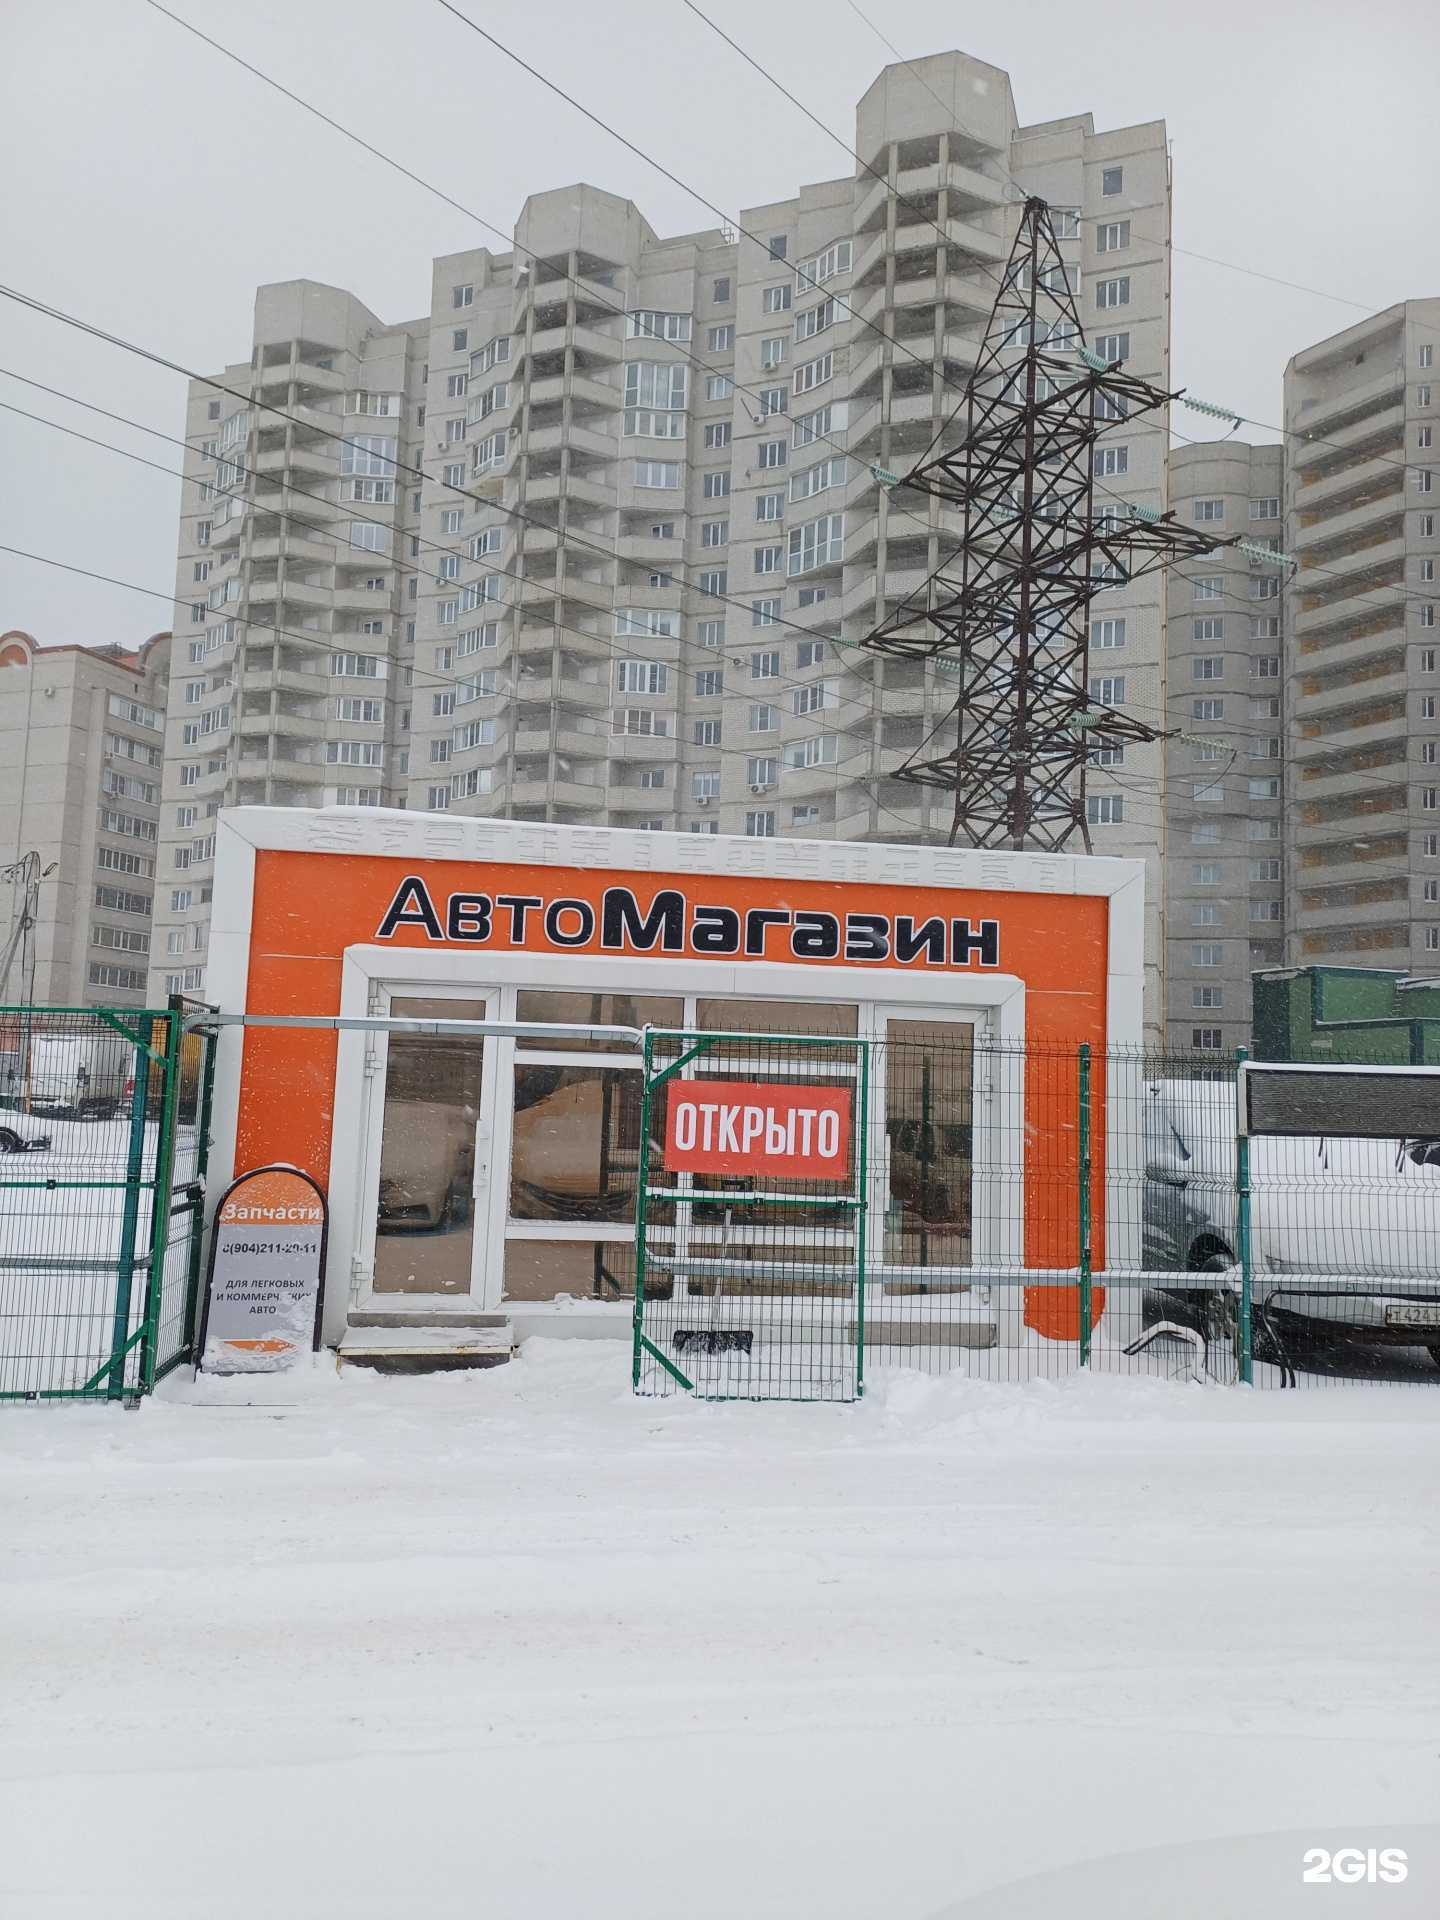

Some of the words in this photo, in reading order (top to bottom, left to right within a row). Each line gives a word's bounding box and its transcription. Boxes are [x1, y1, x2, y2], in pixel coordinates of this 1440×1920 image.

[374, 875, 1000, 967] АвтоМагазин
[675, 1103, 840, 1158] ОТКРЫТО
[224, 1204, 320, 1220] Запчасти
[225, 1280, 248, 1290] ДЛЯ
[250, 1280, 305, 1289] ЛЕГКОВЫХ
[216, 1292, 224, 1301] И
[249, 1306, 277, 1314] АВТО
